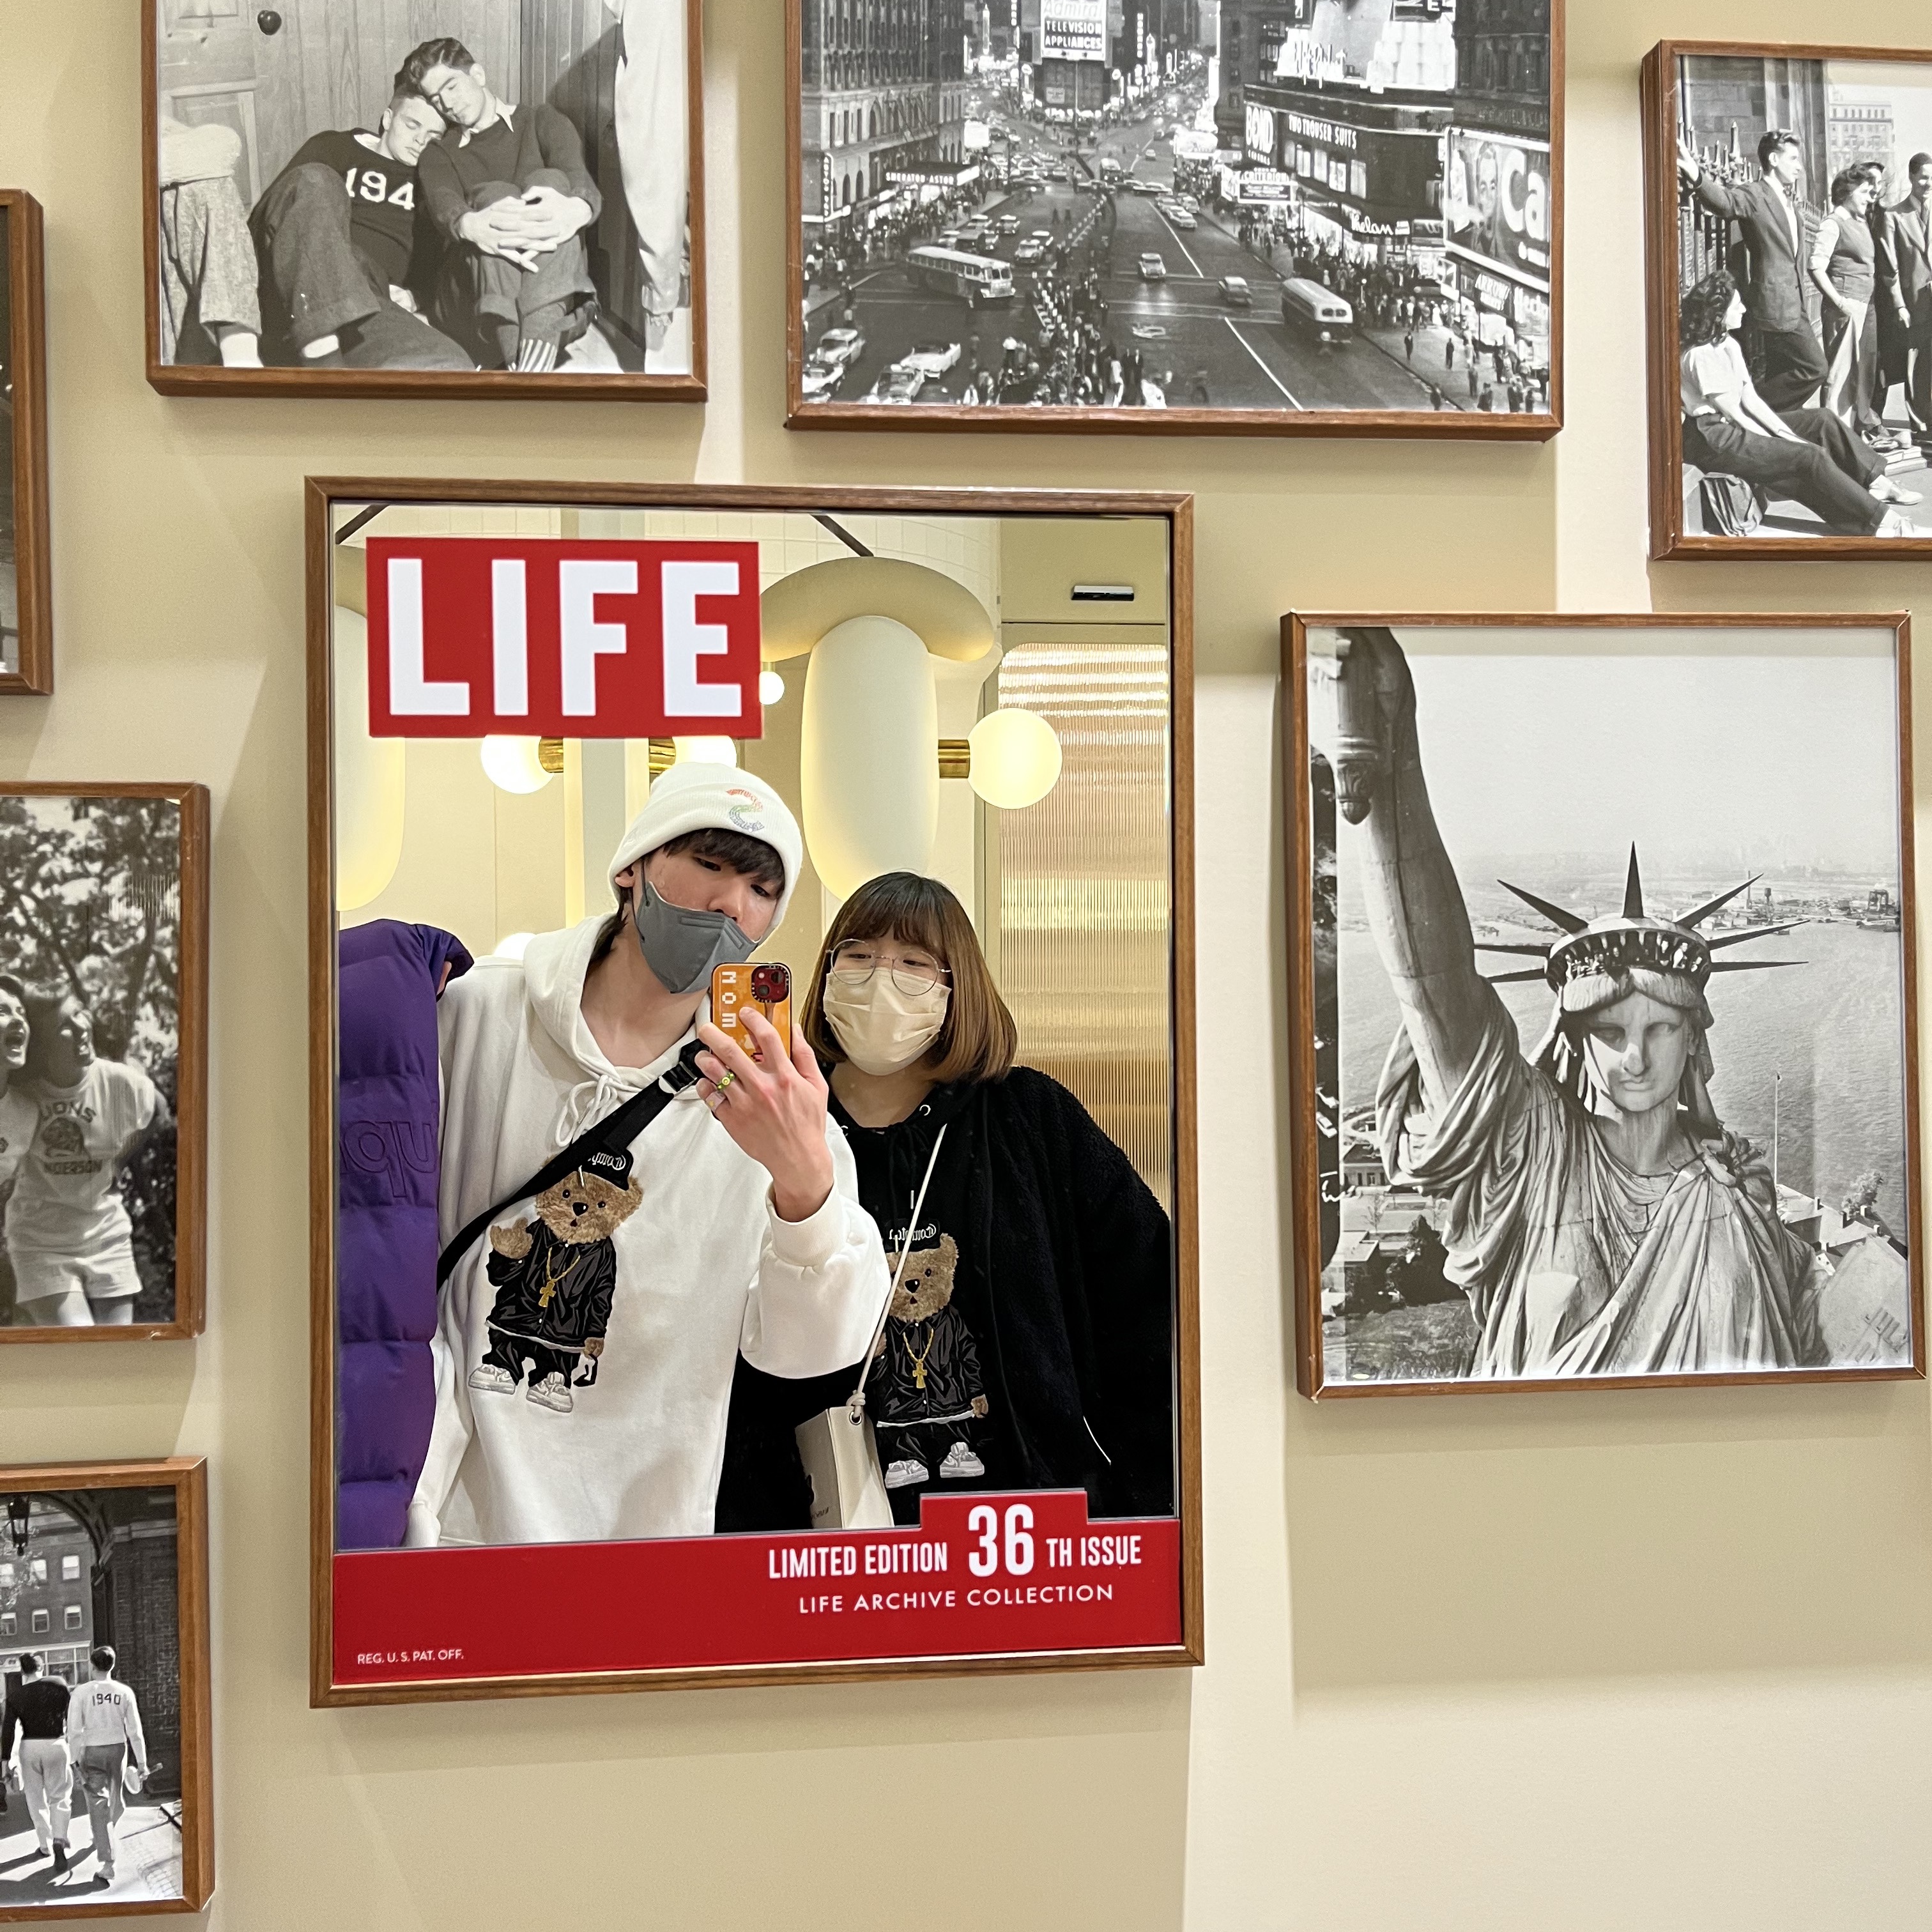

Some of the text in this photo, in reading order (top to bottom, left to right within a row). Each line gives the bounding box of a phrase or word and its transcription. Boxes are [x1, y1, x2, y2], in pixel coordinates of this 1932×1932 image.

[1046, 20, 1101, 34] TELEVISION
[1045, 35, 1102, 49] APPLIANCES
[1246, 106, 1273, 153] BOND
[1335, 126, 1357, 150] SUITS
[387, 557, 742, 717] LIFE
[769, 1503, 1142, 1579] LIMITED EDITION 36 TH ISSUE
[799, 1583, 1113, 1614] LIFE ARCHIVE COLLECTION
[357, 1652, 385, 1665] REG.
[413, 1650, 436, 1661] PAT.
[438, 1648, 464, 1660] OFF.
[92, 1693, 121, 1706] 1940
